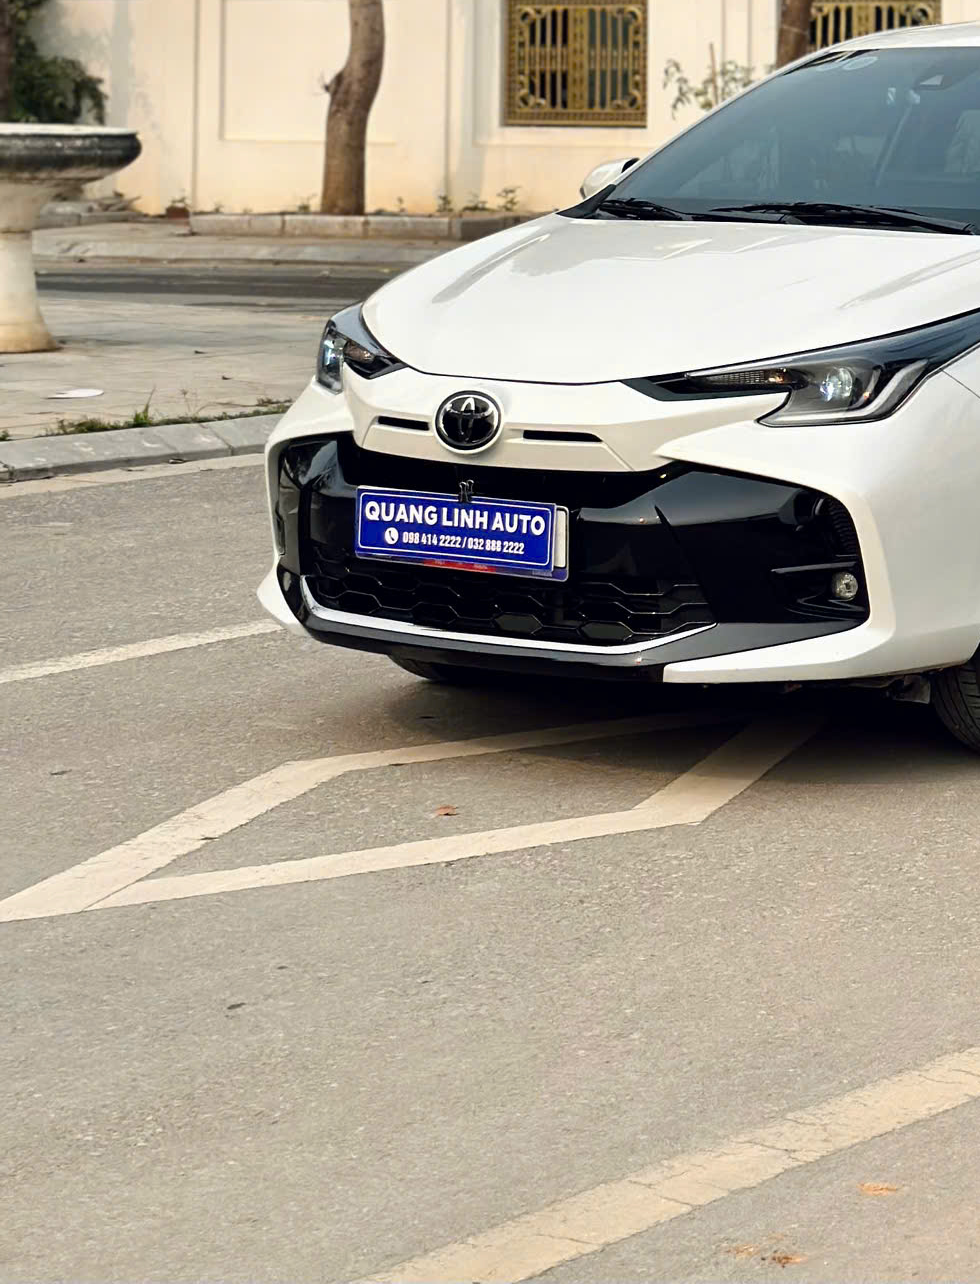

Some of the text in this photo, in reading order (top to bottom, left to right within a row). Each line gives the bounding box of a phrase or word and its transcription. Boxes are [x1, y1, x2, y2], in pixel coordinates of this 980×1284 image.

[365, 501, 545, 536] QUANG LINH AUTO
[402, 531, 420, 544] 098
[421, 533, 438, 546] 414
[439, 534, 461, 548] 2222
[467, 537, 485, 550] 032
[502, 541, 525, 554] 2222
